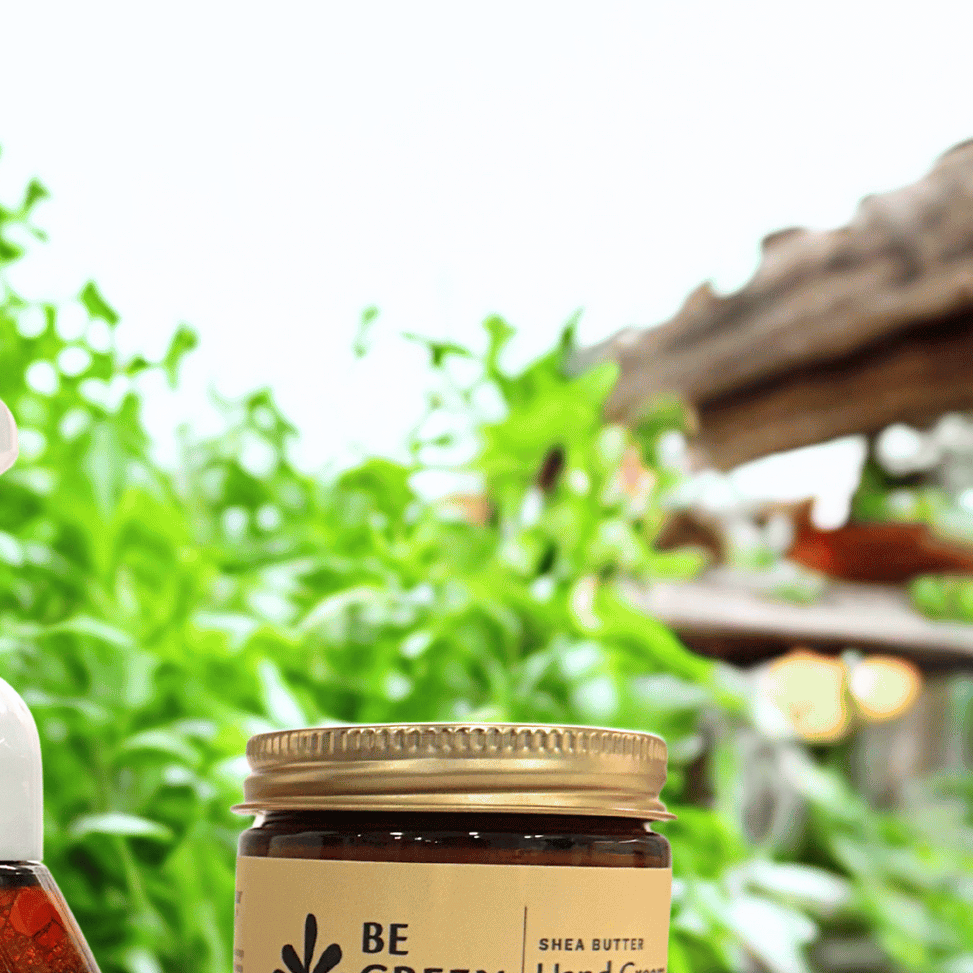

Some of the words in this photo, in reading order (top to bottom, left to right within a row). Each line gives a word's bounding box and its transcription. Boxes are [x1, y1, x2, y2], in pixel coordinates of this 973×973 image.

[362, 922, 409, 955] BE
[538, 938, 585, 951] SHEA
[592, 938, 644, 951] BUTTER
